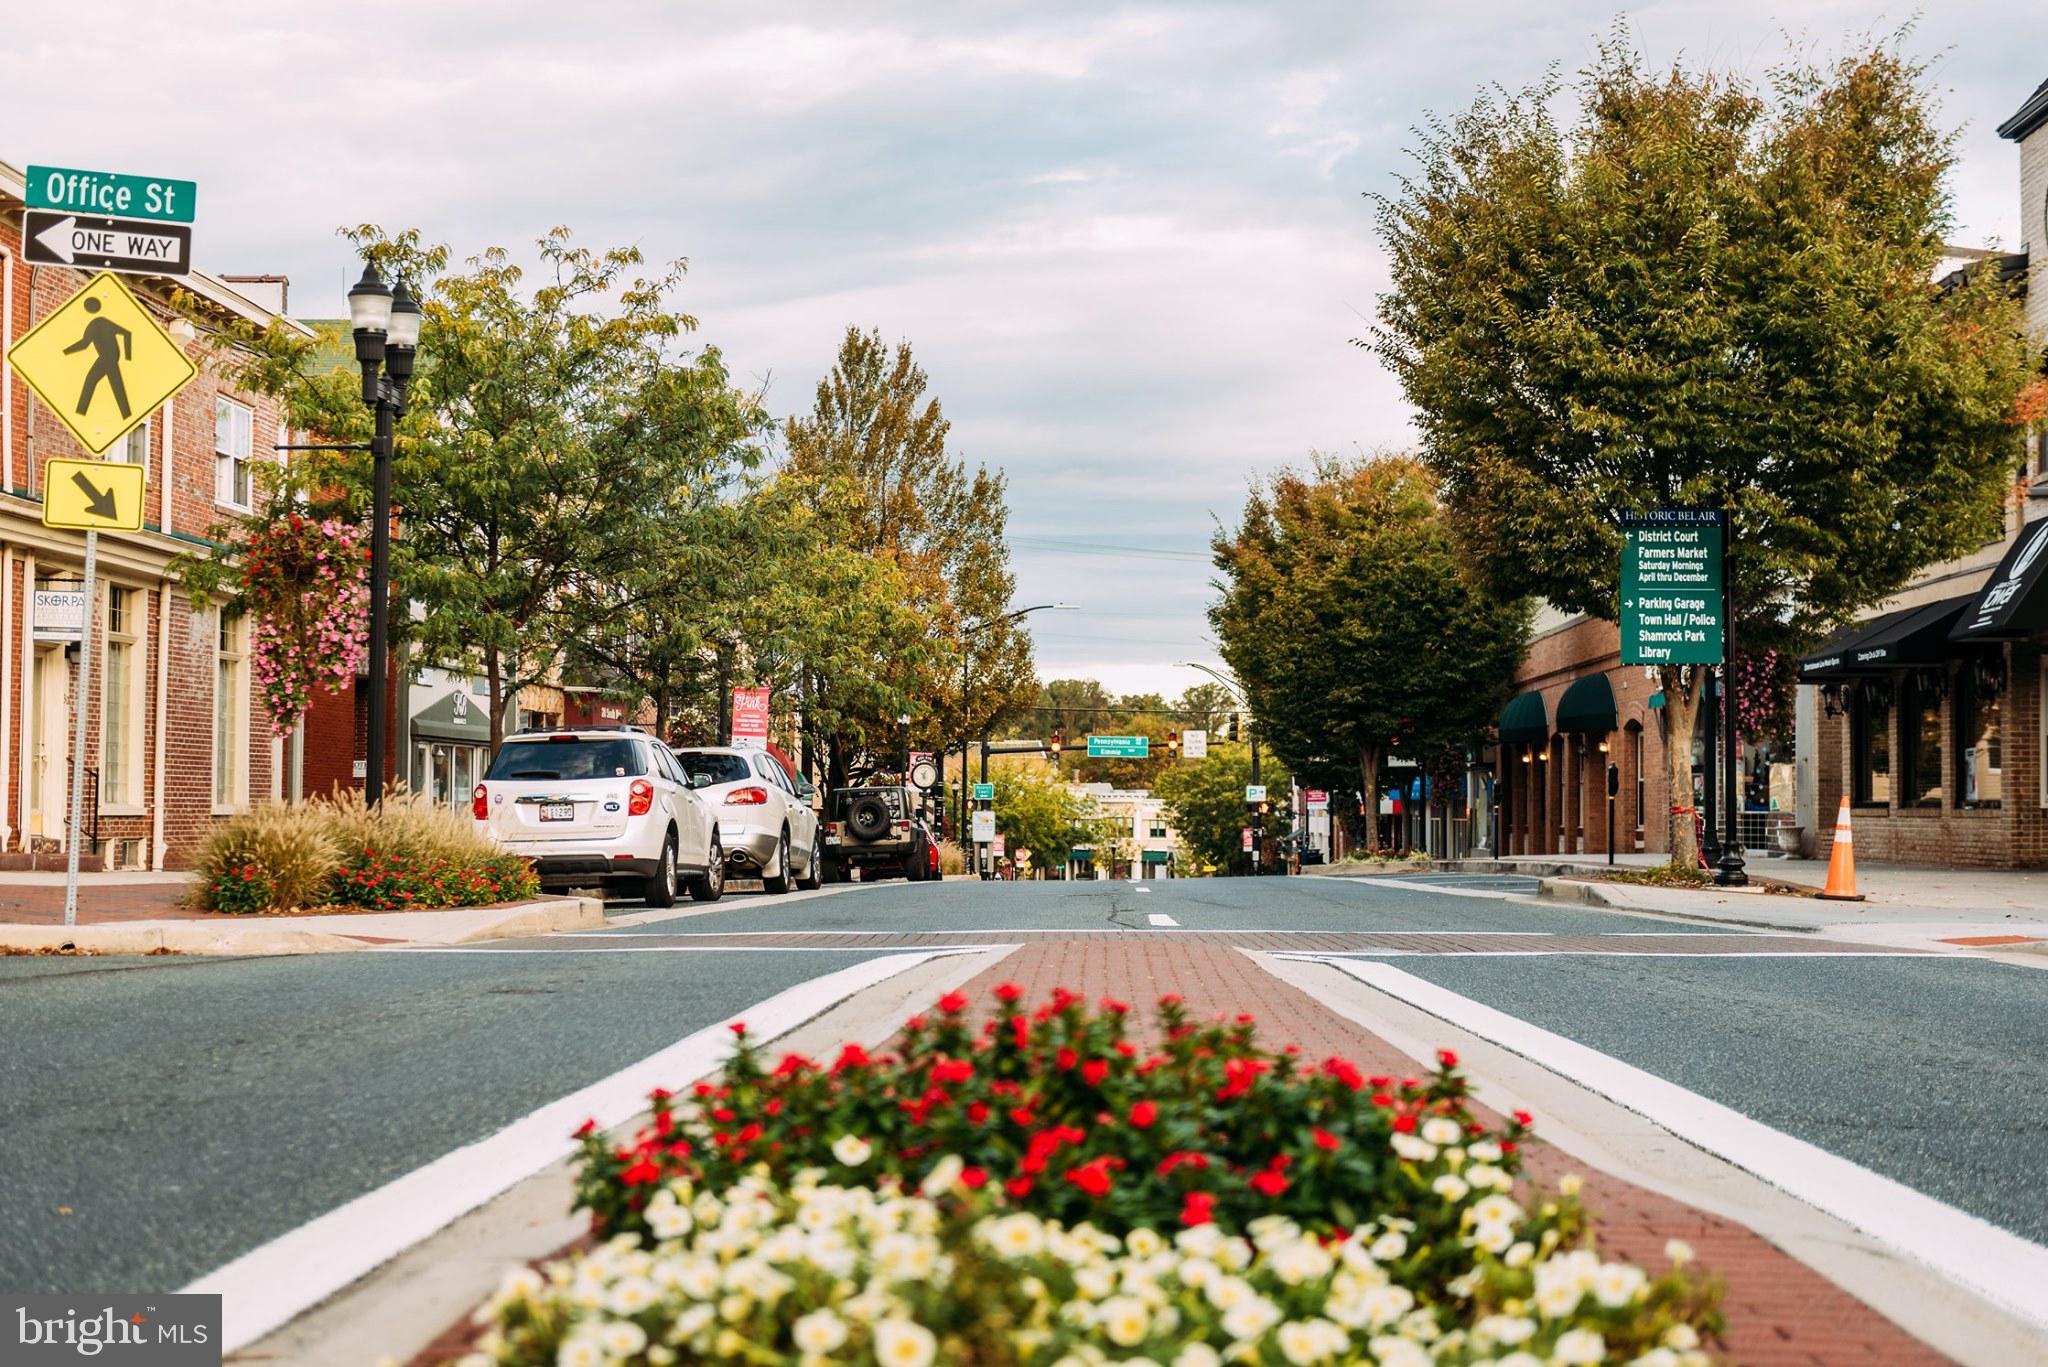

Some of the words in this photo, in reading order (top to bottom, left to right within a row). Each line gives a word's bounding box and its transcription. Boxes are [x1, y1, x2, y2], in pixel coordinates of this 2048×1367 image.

[47, 172, 132, 210] Office
[144, 182, 176, 214] St
[71, 231, 115, 253] ONE
[127, 236, 172, 258] WAY
[1678, 511, 1696, 520] BEL
[1698, 511, 1716, 520] AIR
[1638, 530, 1672, 542] District
[1673, 530, 1699, 542] Court
[1638, 547, 1675, 558] Farmers
[1677, 547, 1708, 558] Market
[1638, 560, 1670, 572] Saturday
[1672, 561, 1704, 572] Mornings
[1638, 572, 1656, 583] April
[1657, 572, 1672, 581] thru
[1673, 572, 1708, 581] December
[1638, 597, 1672, 611] Parking
[1674, 597, 1705, 611] Garage
[1638, 613, 1662, 625] Town
[1664, 613, 1681, 625] Hall
[1689, 613, 1716, 625] Police
[1639, 630, 1683, 642] Shamrock
[1684, 630, 1706, 642] Park
[1639, 646, 1671, 660] Library
[1248, 788, 1257, 798] P
